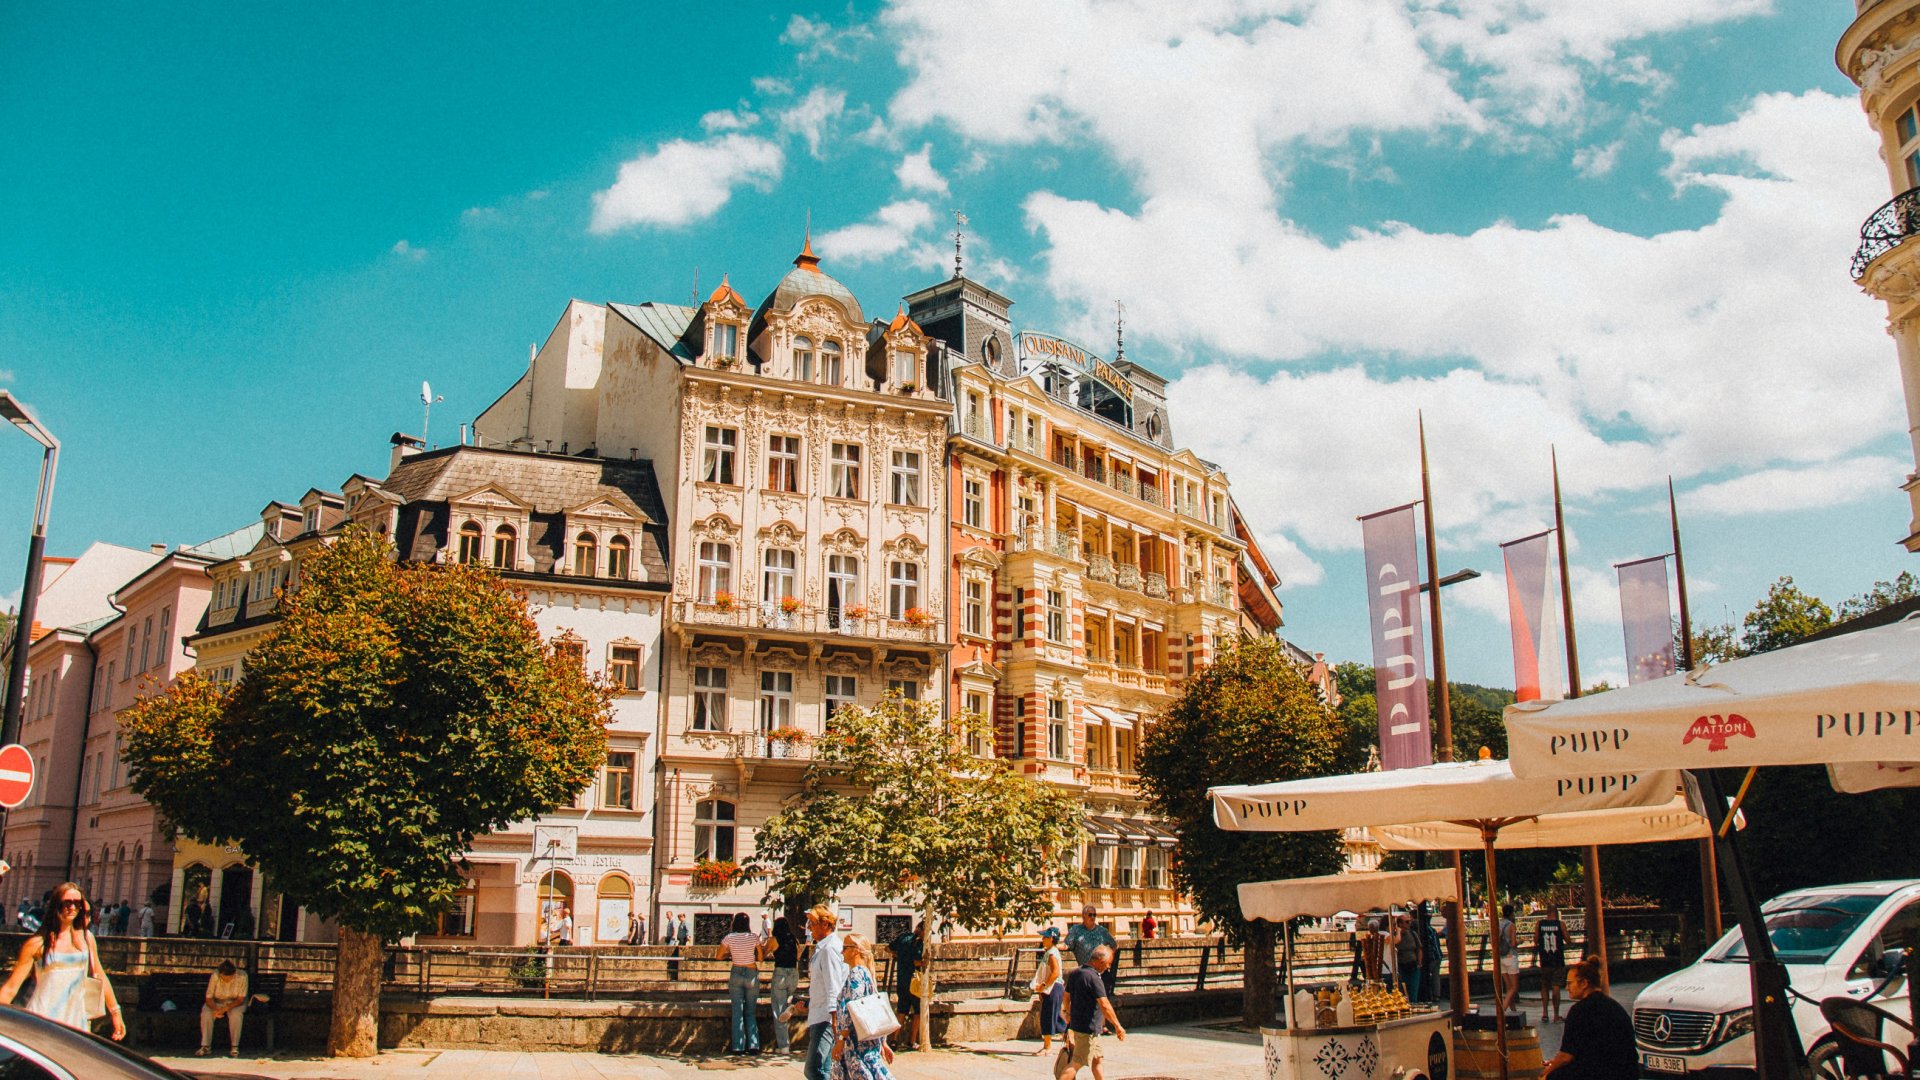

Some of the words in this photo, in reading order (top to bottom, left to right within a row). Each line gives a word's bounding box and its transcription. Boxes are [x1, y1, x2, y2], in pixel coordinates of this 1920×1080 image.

[1024, 336, 1086, 368] QUISISANA
[1095, 359, 1134, 400] PALACE
[1379, 563, 1421, 736] PUPP
[1692, 723, 1747, 735] MATTONI
[1817, 710, 1920, 738] PUPP
[1551, 728, 1629, 755] PUPP
[1558, 774, 1637, 796] PUPP
[1242, 800, 1307, 818] PUPP
